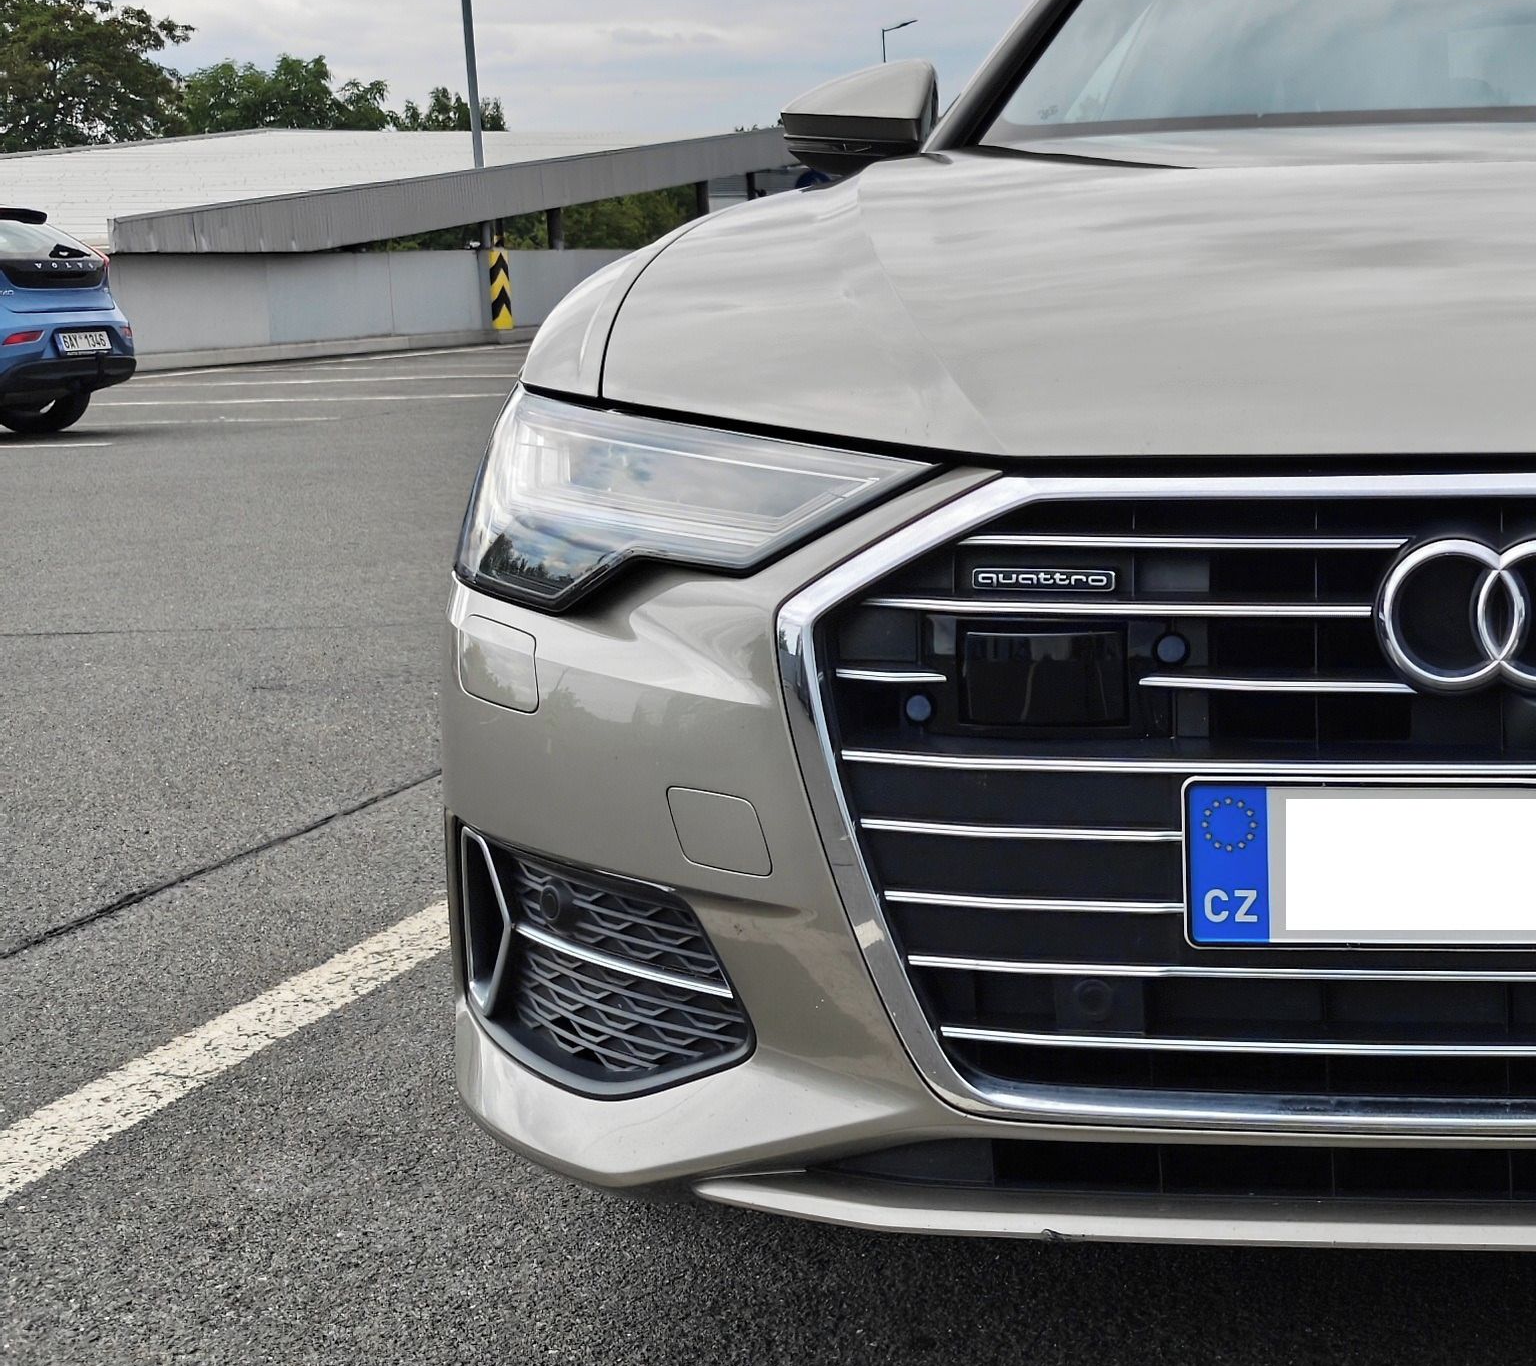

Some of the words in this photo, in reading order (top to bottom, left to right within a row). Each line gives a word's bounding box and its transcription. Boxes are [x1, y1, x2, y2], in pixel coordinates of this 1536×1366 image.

[62, 333, 80, 349] 6AY
[978, 572, 1108, 587] quattro
[1204, 888, 1258, 923] CZ
